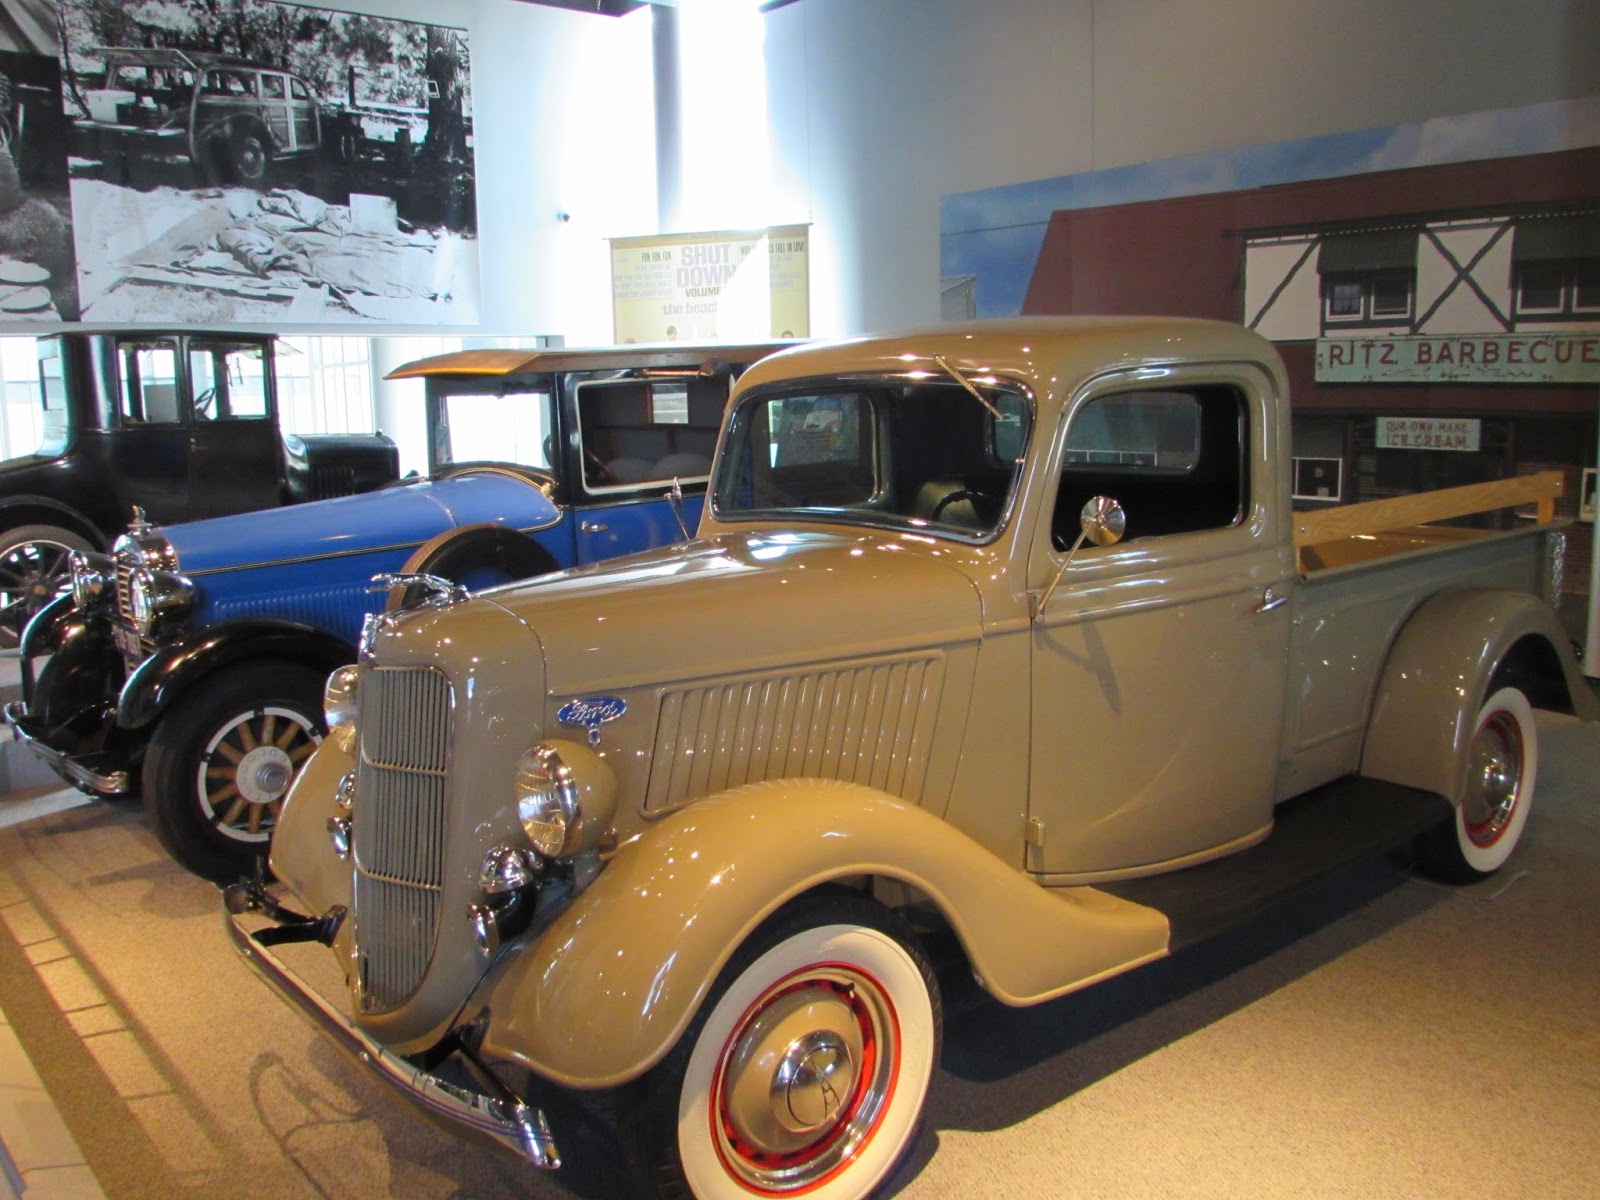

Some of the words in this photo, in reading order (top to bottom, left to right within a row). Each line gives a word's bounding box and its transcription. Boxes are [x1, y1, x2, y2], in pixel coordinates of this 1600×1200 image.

[680, 243, 731, 267] SHUT
[676, 264, 737, 288] DOWN
[685, 286, 721, 298] VOLUME
[662, 303, 684, 316] the
[1329, 341, 1398, 367] RITZ
[1415, 339, 1600, 365] BARBECUE
[1386, 420, 1407, 432] OUR
[1411, 421, 1434, 432] OWN
[1438, 422, 1469, 434] MAKE
[1386, 432, 1409, 446] ICE
[1414, 433, 1469, 448] CREAM
